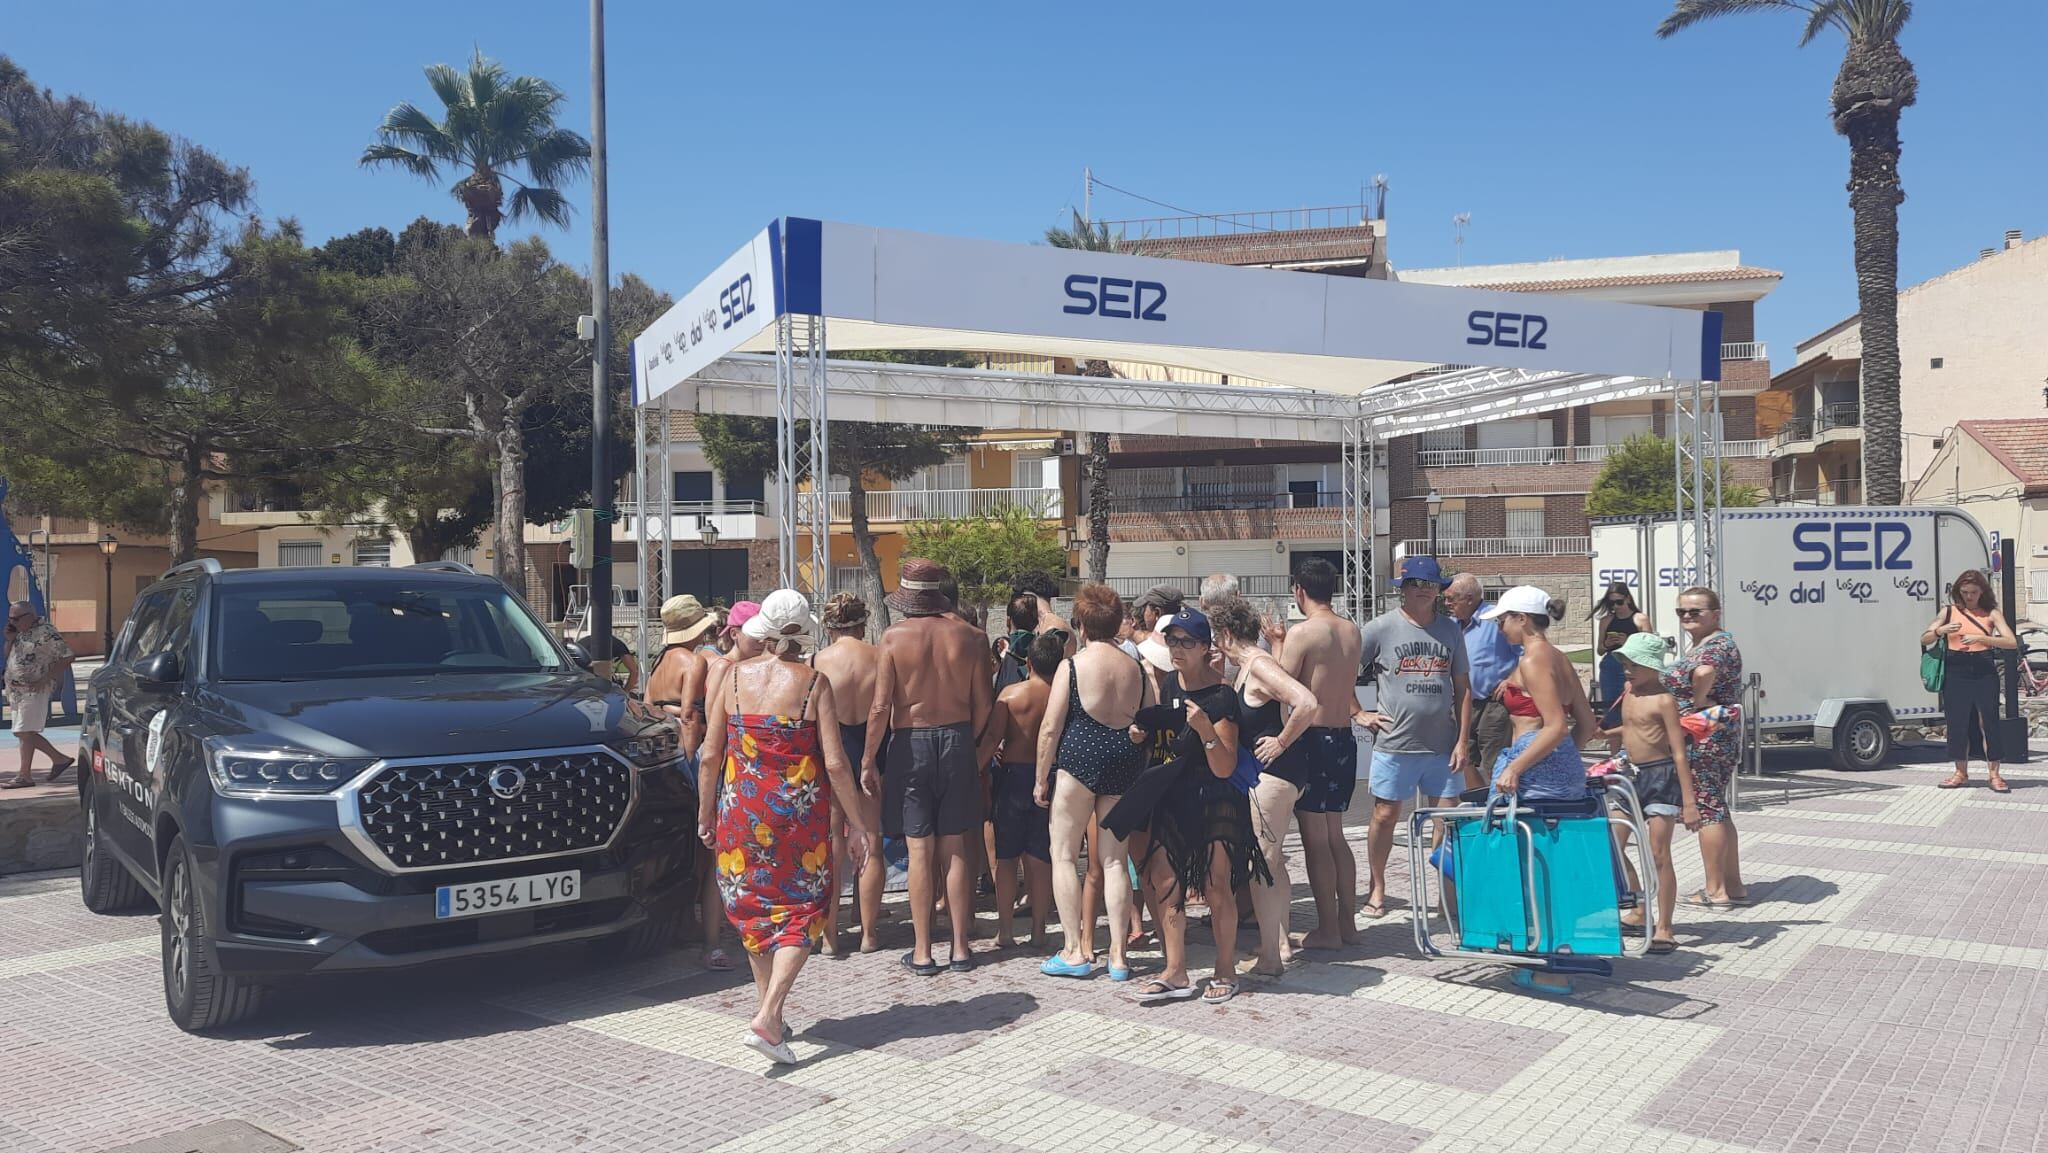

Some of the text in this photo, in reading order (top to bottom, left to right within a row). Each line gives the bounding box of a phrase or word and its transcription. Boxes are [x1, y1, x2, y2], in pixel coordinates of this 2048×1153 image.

[720, 272, 756, 331] SER
[1063, 274, 1168, 322] SER
[1466, 310, 1548, 350] SER
[1793, 522, 1913, 571] SER
[1600, 569, 1640, 588] SER
[1790, 580, 1825, 604] dial
[1394, 641, 1451, 661] ORIGINALS
[104, 757, 153, 811] REXTON
[455, 875, 574, 912] 5354 LYG
